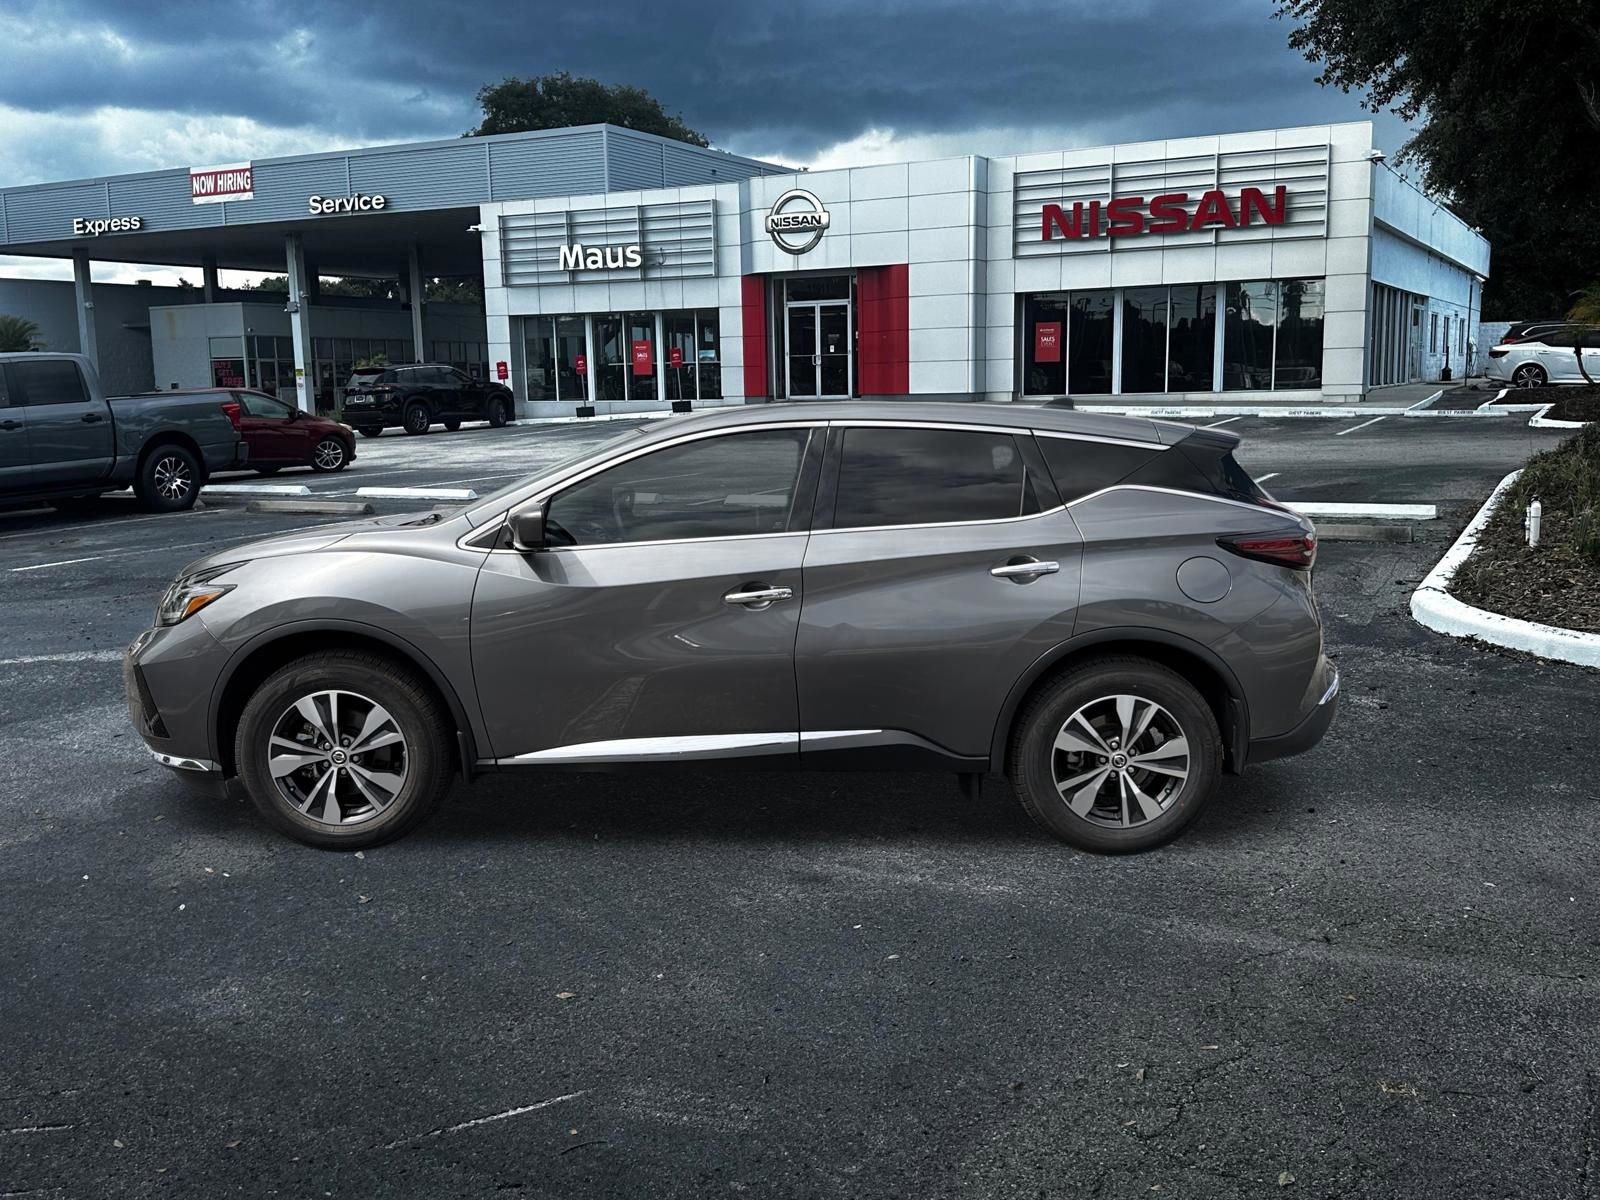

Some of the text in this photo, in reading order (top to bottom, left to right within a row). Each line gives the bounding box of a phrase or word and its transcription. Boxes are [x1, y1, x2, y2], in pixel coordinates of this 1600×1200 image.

[192, 171, 251, 195] NOW HIRING
[309, 193, 385, 214] Service
[1042, 185, 1287, 241] NISSAN
[73, 216, 141, 236] Express
[769, 214, 823, 230] NISSAN
[559, 243, 642, 271] Maus
